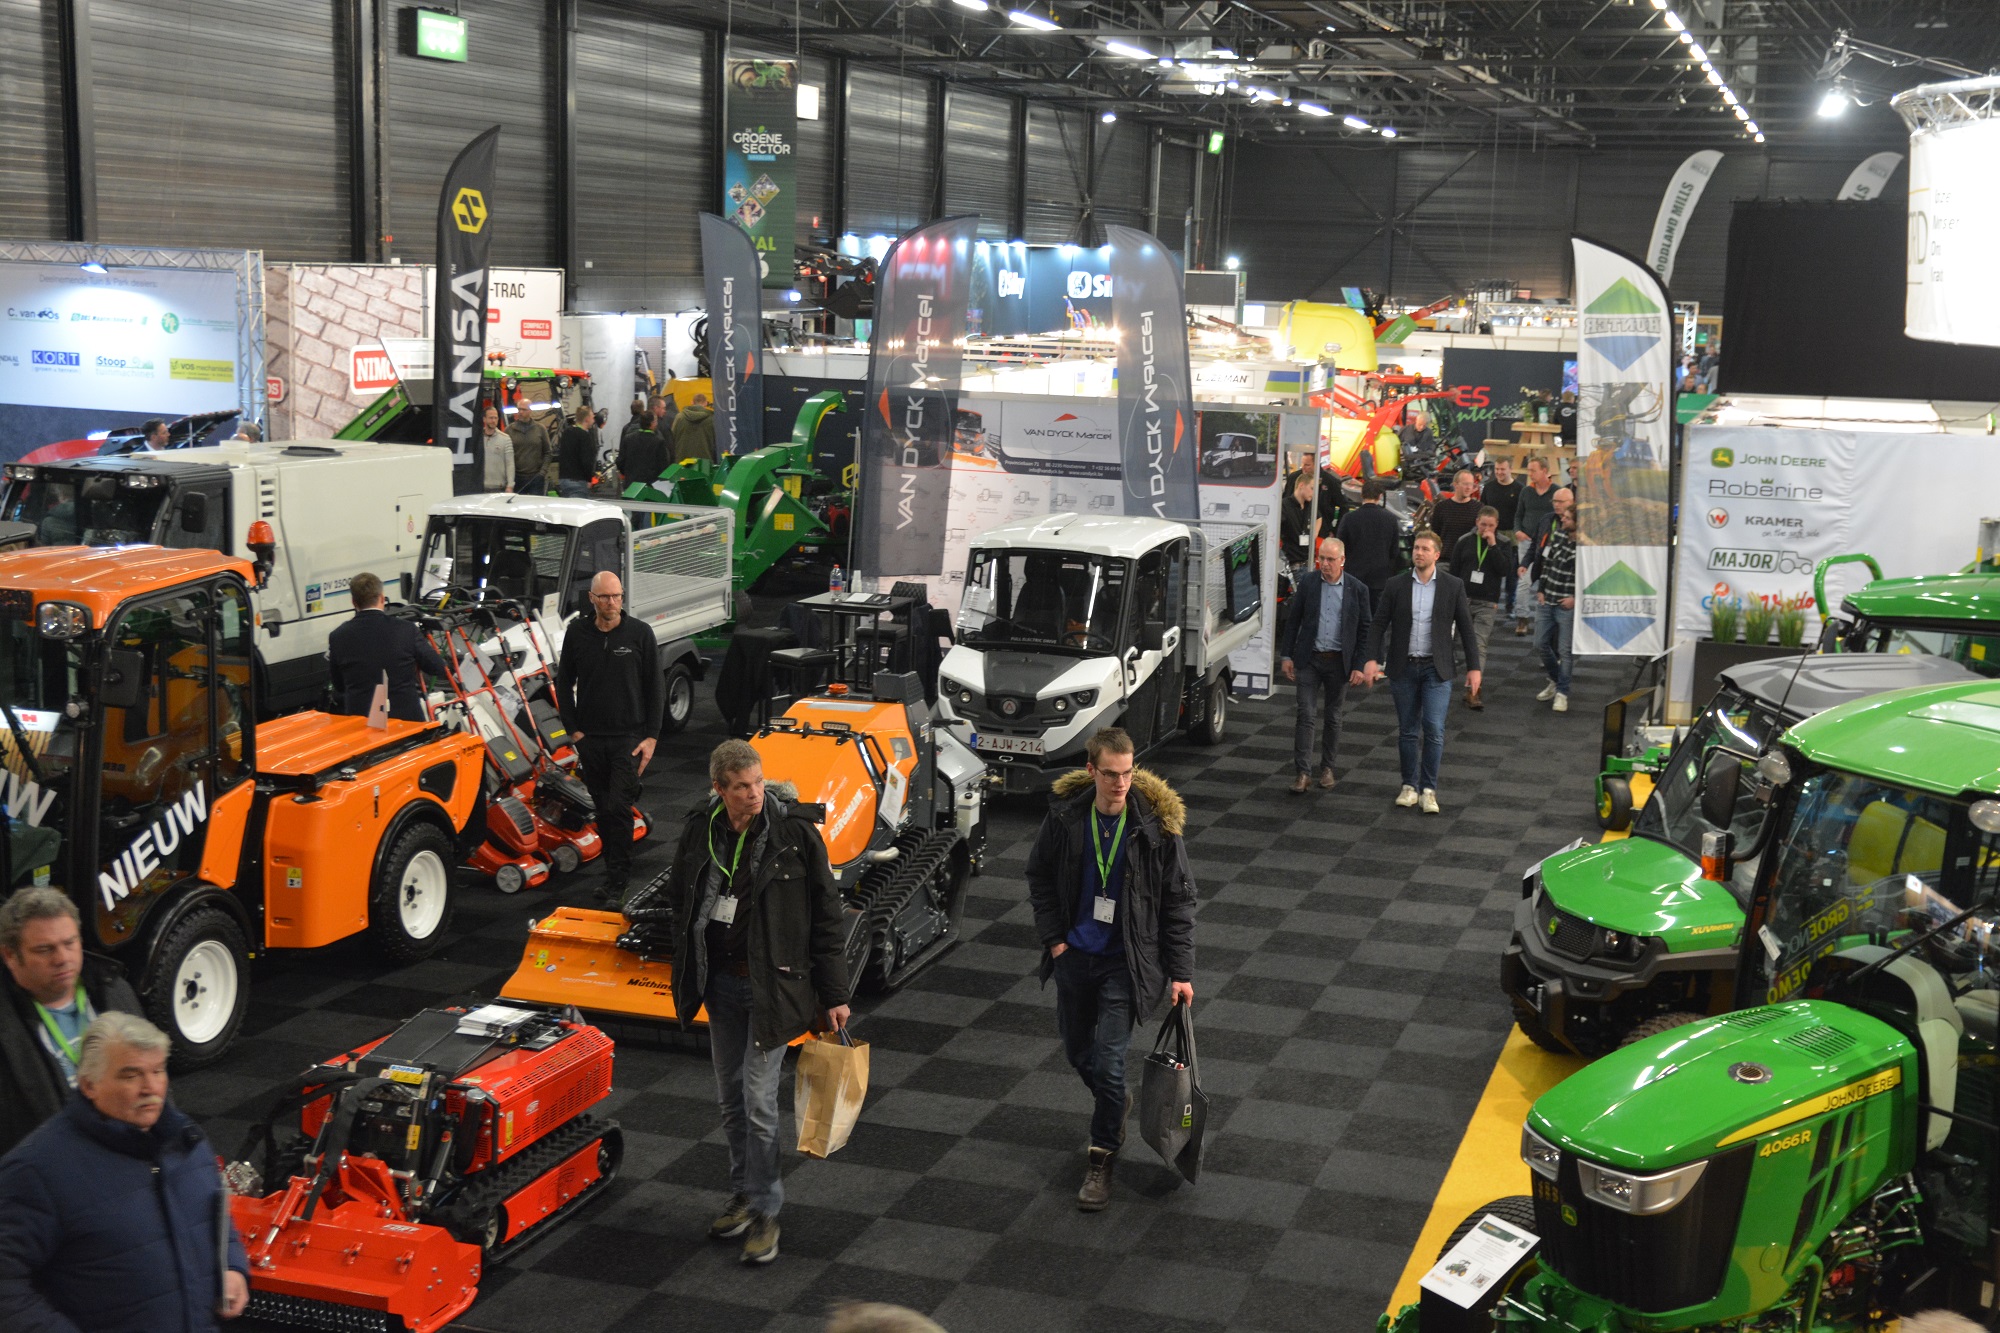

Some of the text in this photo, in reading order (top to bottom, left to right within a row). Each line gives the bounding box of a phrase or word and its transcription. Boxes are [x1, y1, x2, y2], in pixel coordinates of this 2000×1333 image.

[733, 133, 782, 144] GROENE
[742, 144, 791, 155] SECTOR
[1656, 182, 1695, 278] OODLAND MILLS
[20, 310, 36, 319] van
[32, 351, 79, 365] KORT
[97, 356, 127, 368] Stoop
[180, 363, 195, 371] VOS
[447, 269, 484, 465] HANSA
[896, 294, 934, 530] VAN DYCK Marcel
[1024, 429, 1112, 440] VAN DYCK Marcel
[1739, 454, 1827, 468] JOHN DEERE
[1708, 479, 1823, 500] Roberine
[1745, 516, 1804, 528] KRAMER
[1713, 551, 1773, 569] MAJOR
[98, 780, 208, 912] NIEUW
[1823, 1075, 1894, 1113] JOHN DEERE
[1759, 1129, 1812, 1158] 4066R
